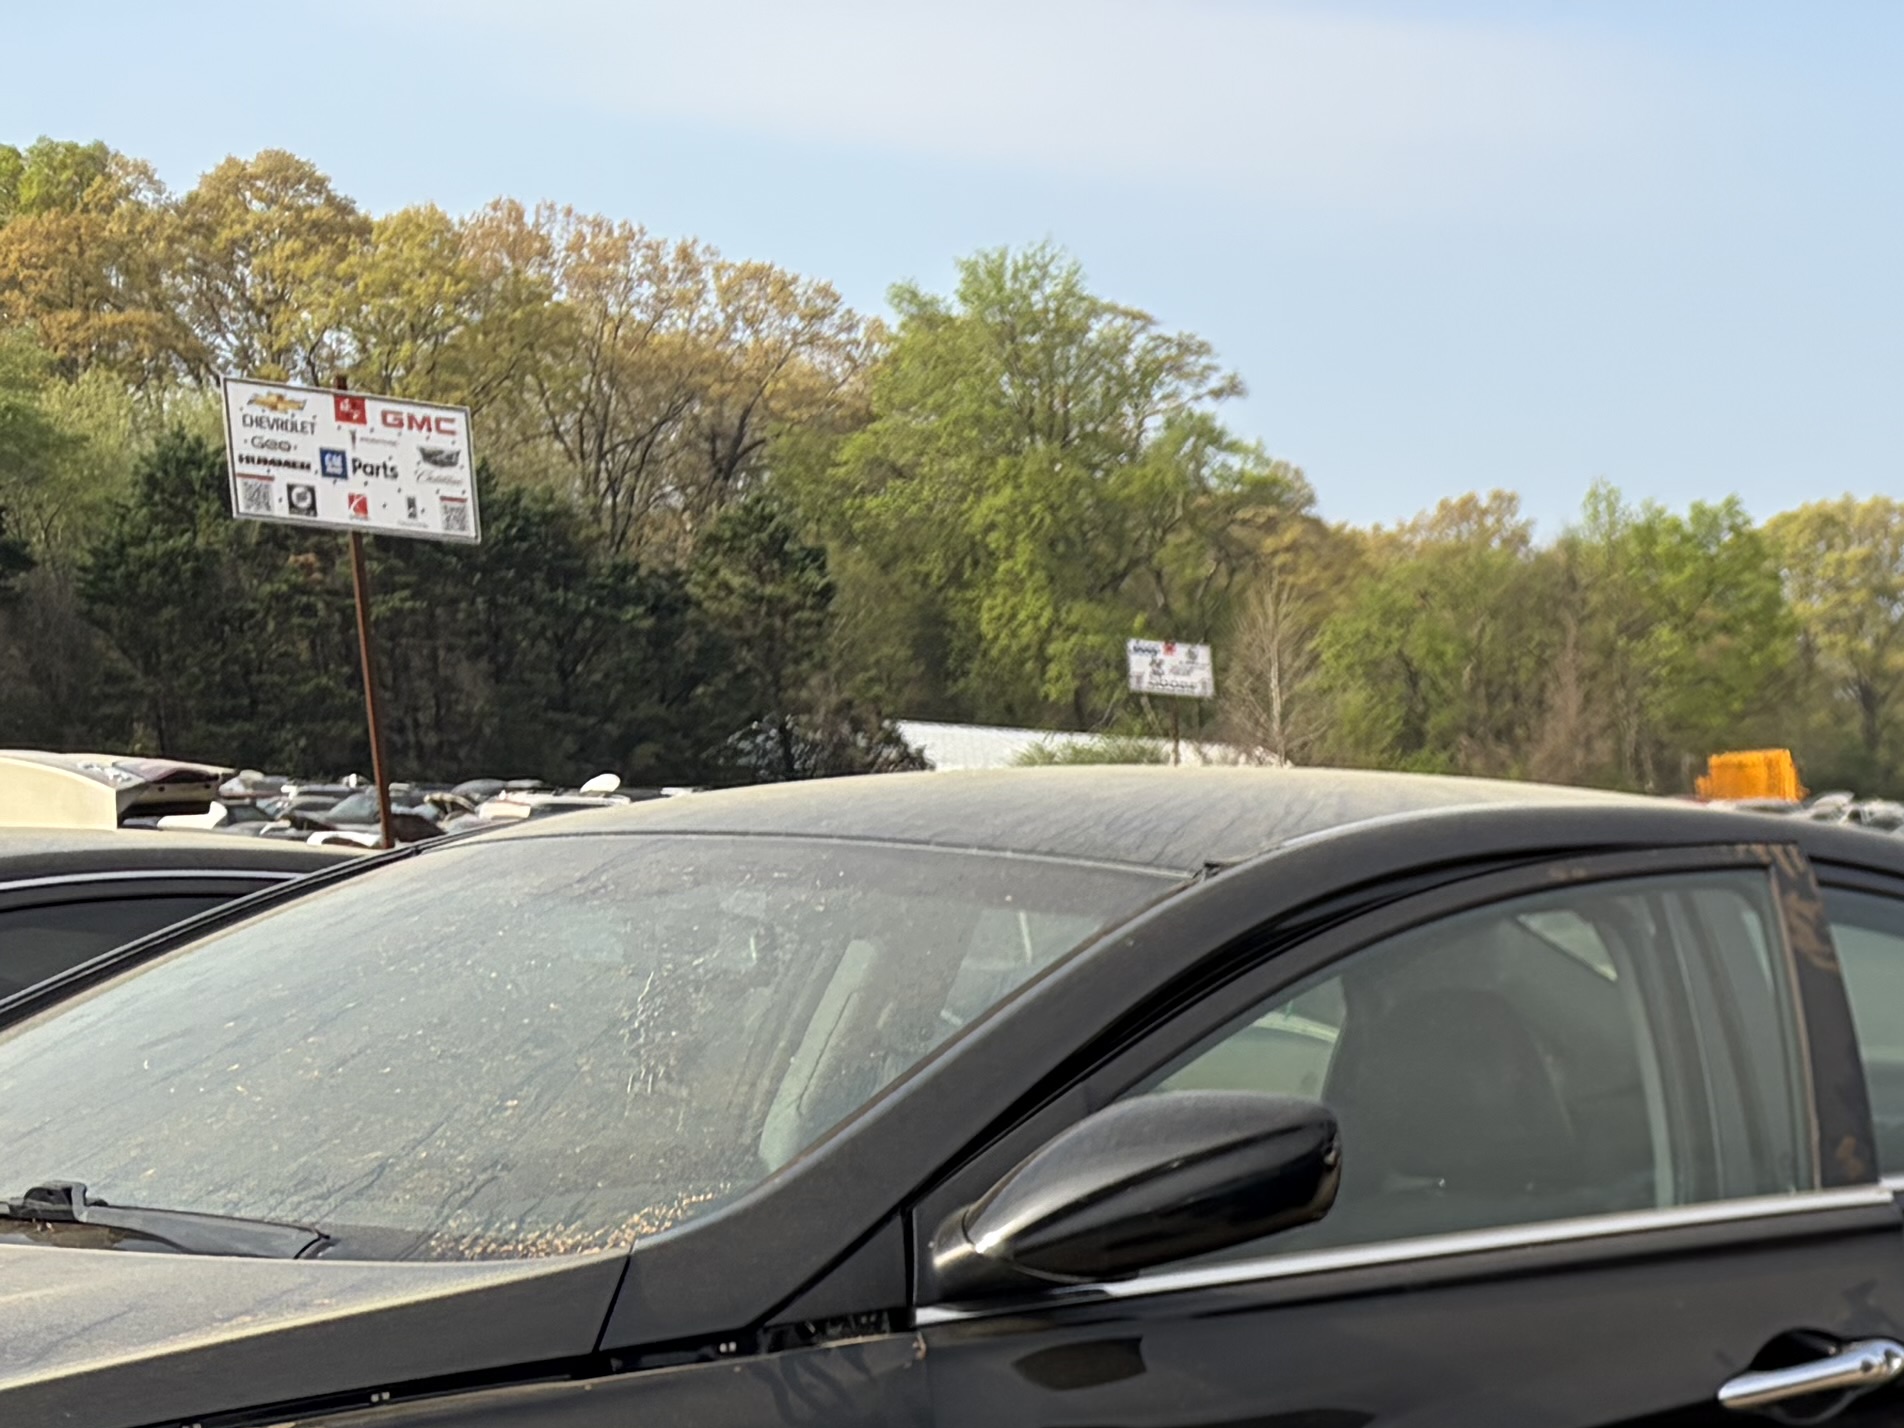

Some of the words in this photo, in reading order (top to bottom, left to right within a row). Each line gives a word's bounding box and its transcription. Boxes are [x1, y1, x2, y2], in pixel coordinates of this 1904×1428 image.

[242, 413, 317, 436] CHEVROLET
[381, 410, 457, 436] GMC
[352, 457, 399, 480] Parts
